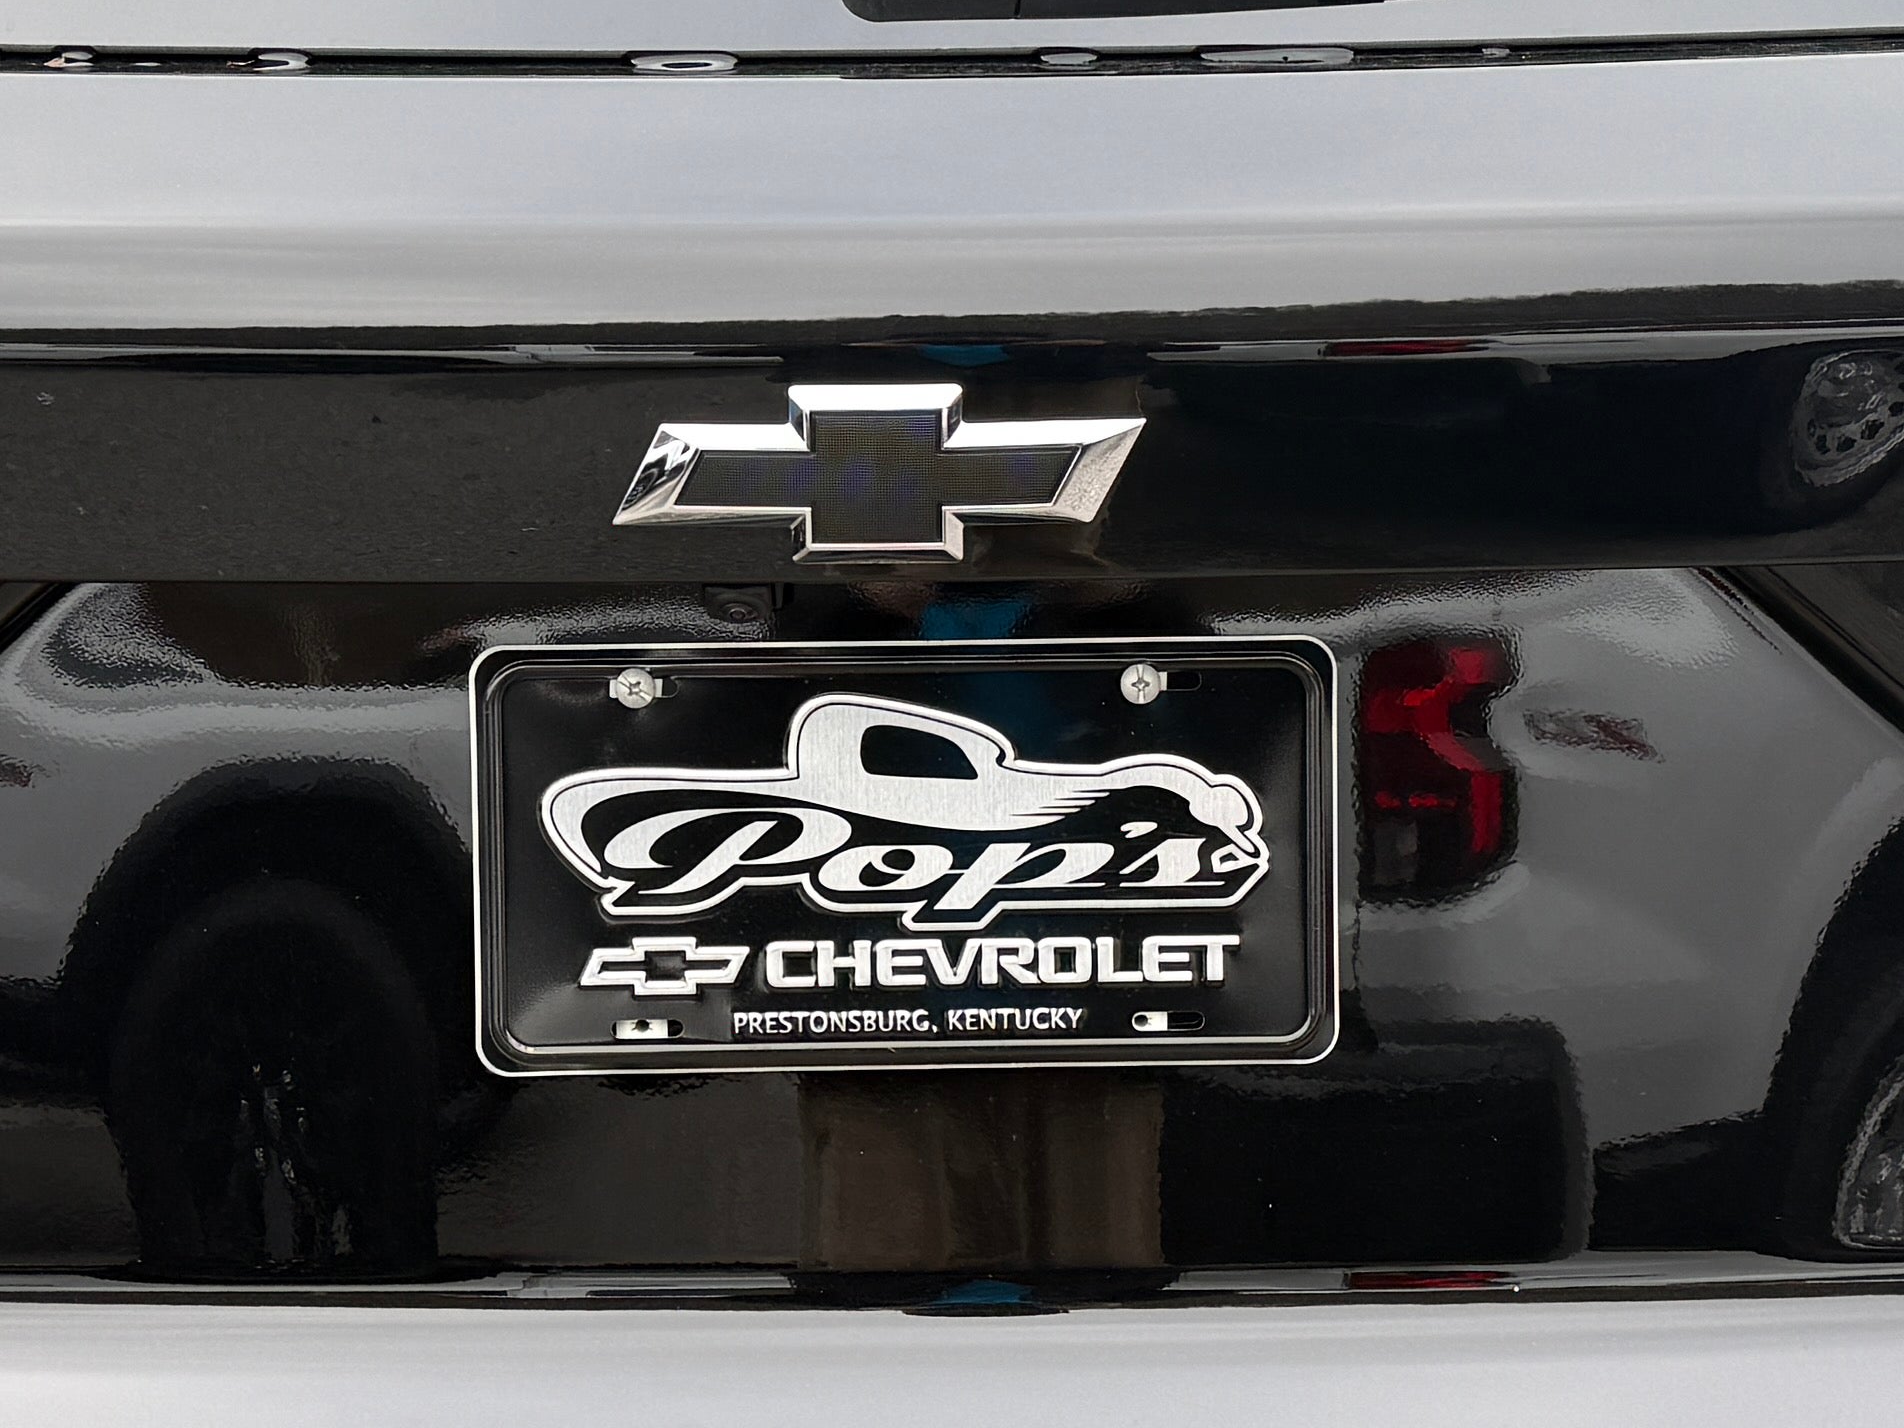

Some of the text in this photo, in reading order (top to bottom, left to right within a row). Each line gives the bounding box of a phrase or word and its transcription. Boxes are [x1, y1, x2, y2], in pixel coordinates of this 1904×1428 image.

[603, 808, 1222, 912] Pop's
[764, 934, 1241, 990] CHEVROLET
[732, 1006, 1084, 1037] PRESTONSBURG, KENTUCKY
